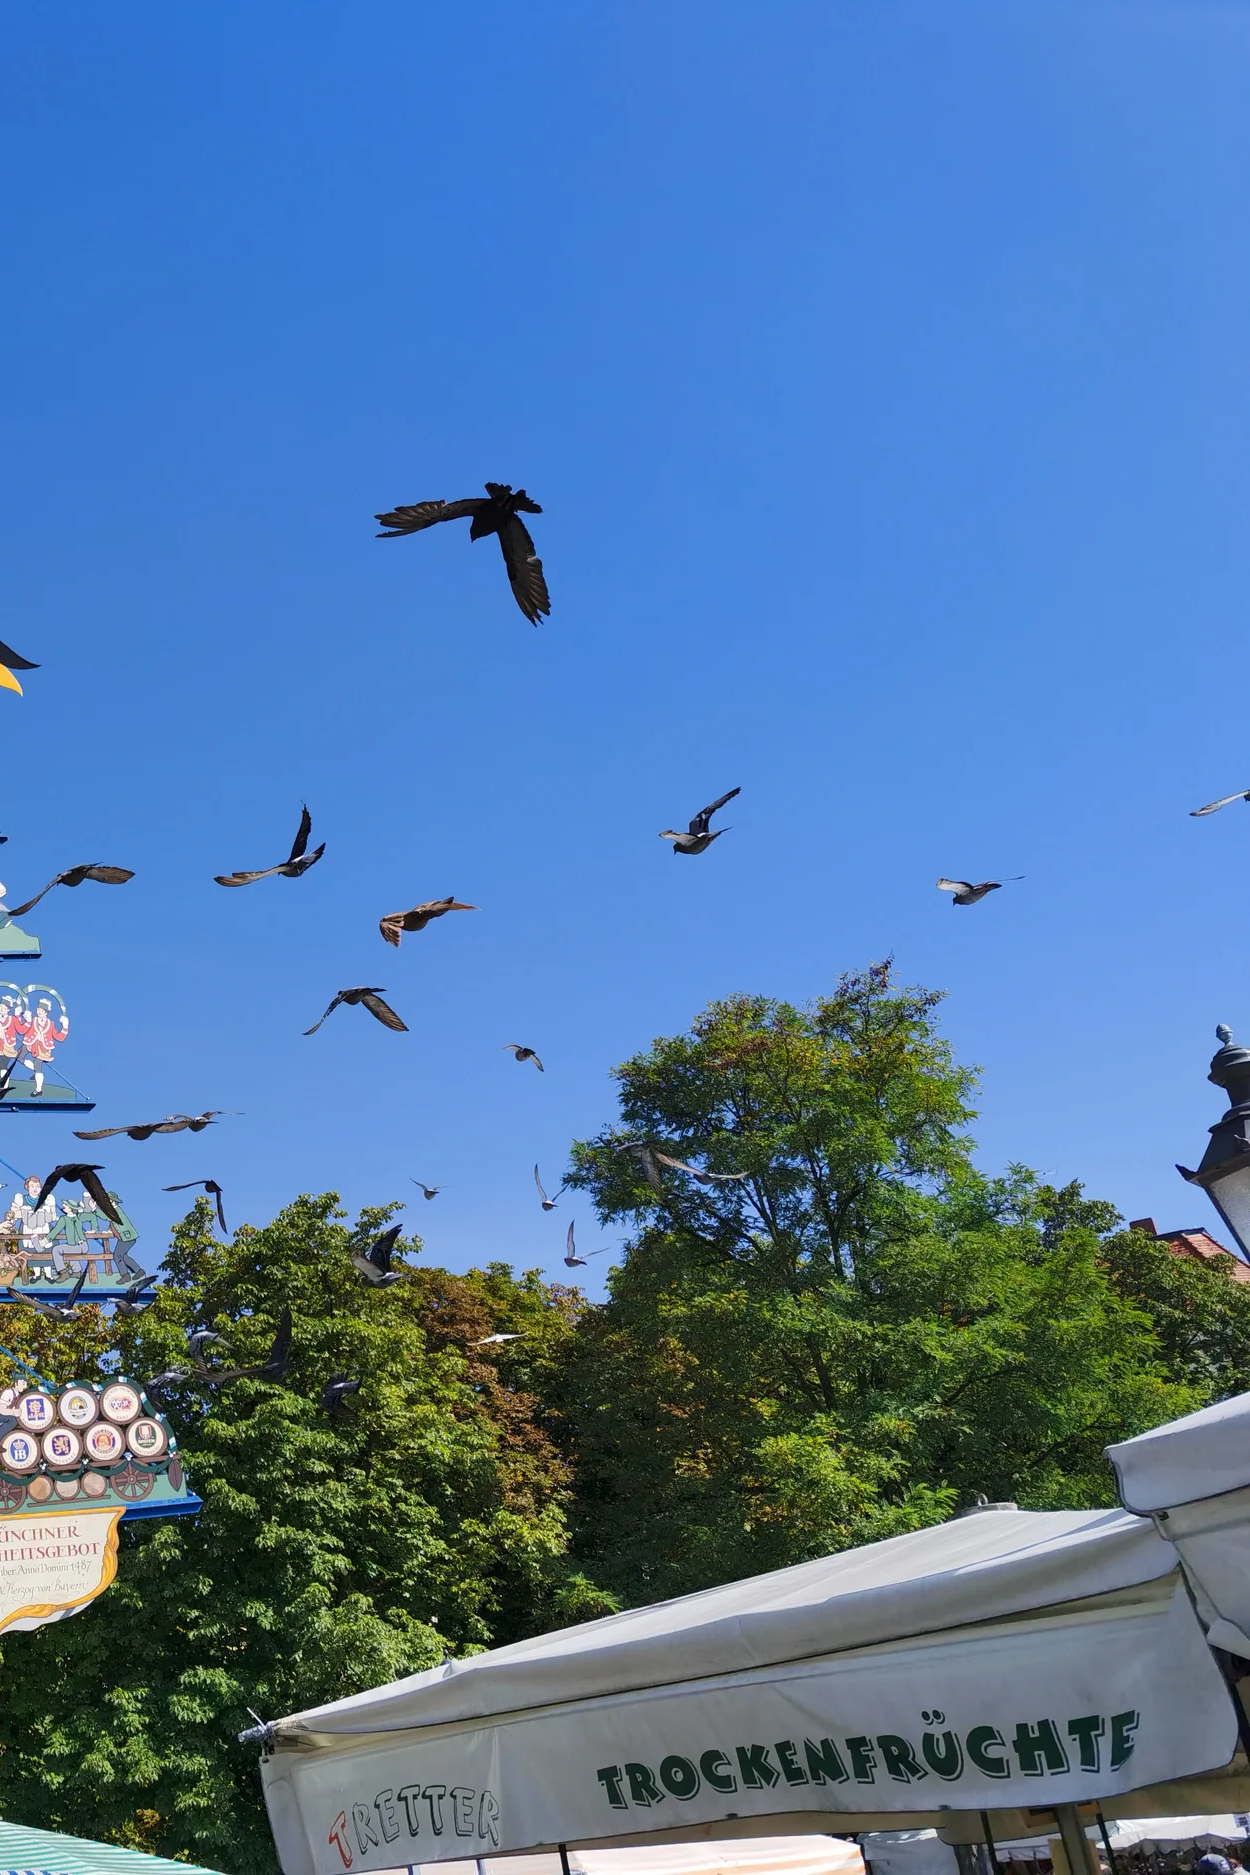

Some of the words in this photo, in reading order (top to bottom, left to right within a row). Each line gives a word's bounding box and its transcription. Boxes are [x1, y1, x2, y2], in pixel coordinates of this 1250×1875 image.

[14, 1449, 27, 1460] HB
[16, 1564, 40, 1576] Anno
[39, 1561, 69, 1574] Domini
[70, 1560, 92, 1576] 1487
[36, 1585, 51, 1595] von
[52, 1577, 88, 1596] Bayern
[597, 1709, 1141, 1810] TROCKENFRÜCHTE
[328, 1784, 500, 1869] TRETTER
